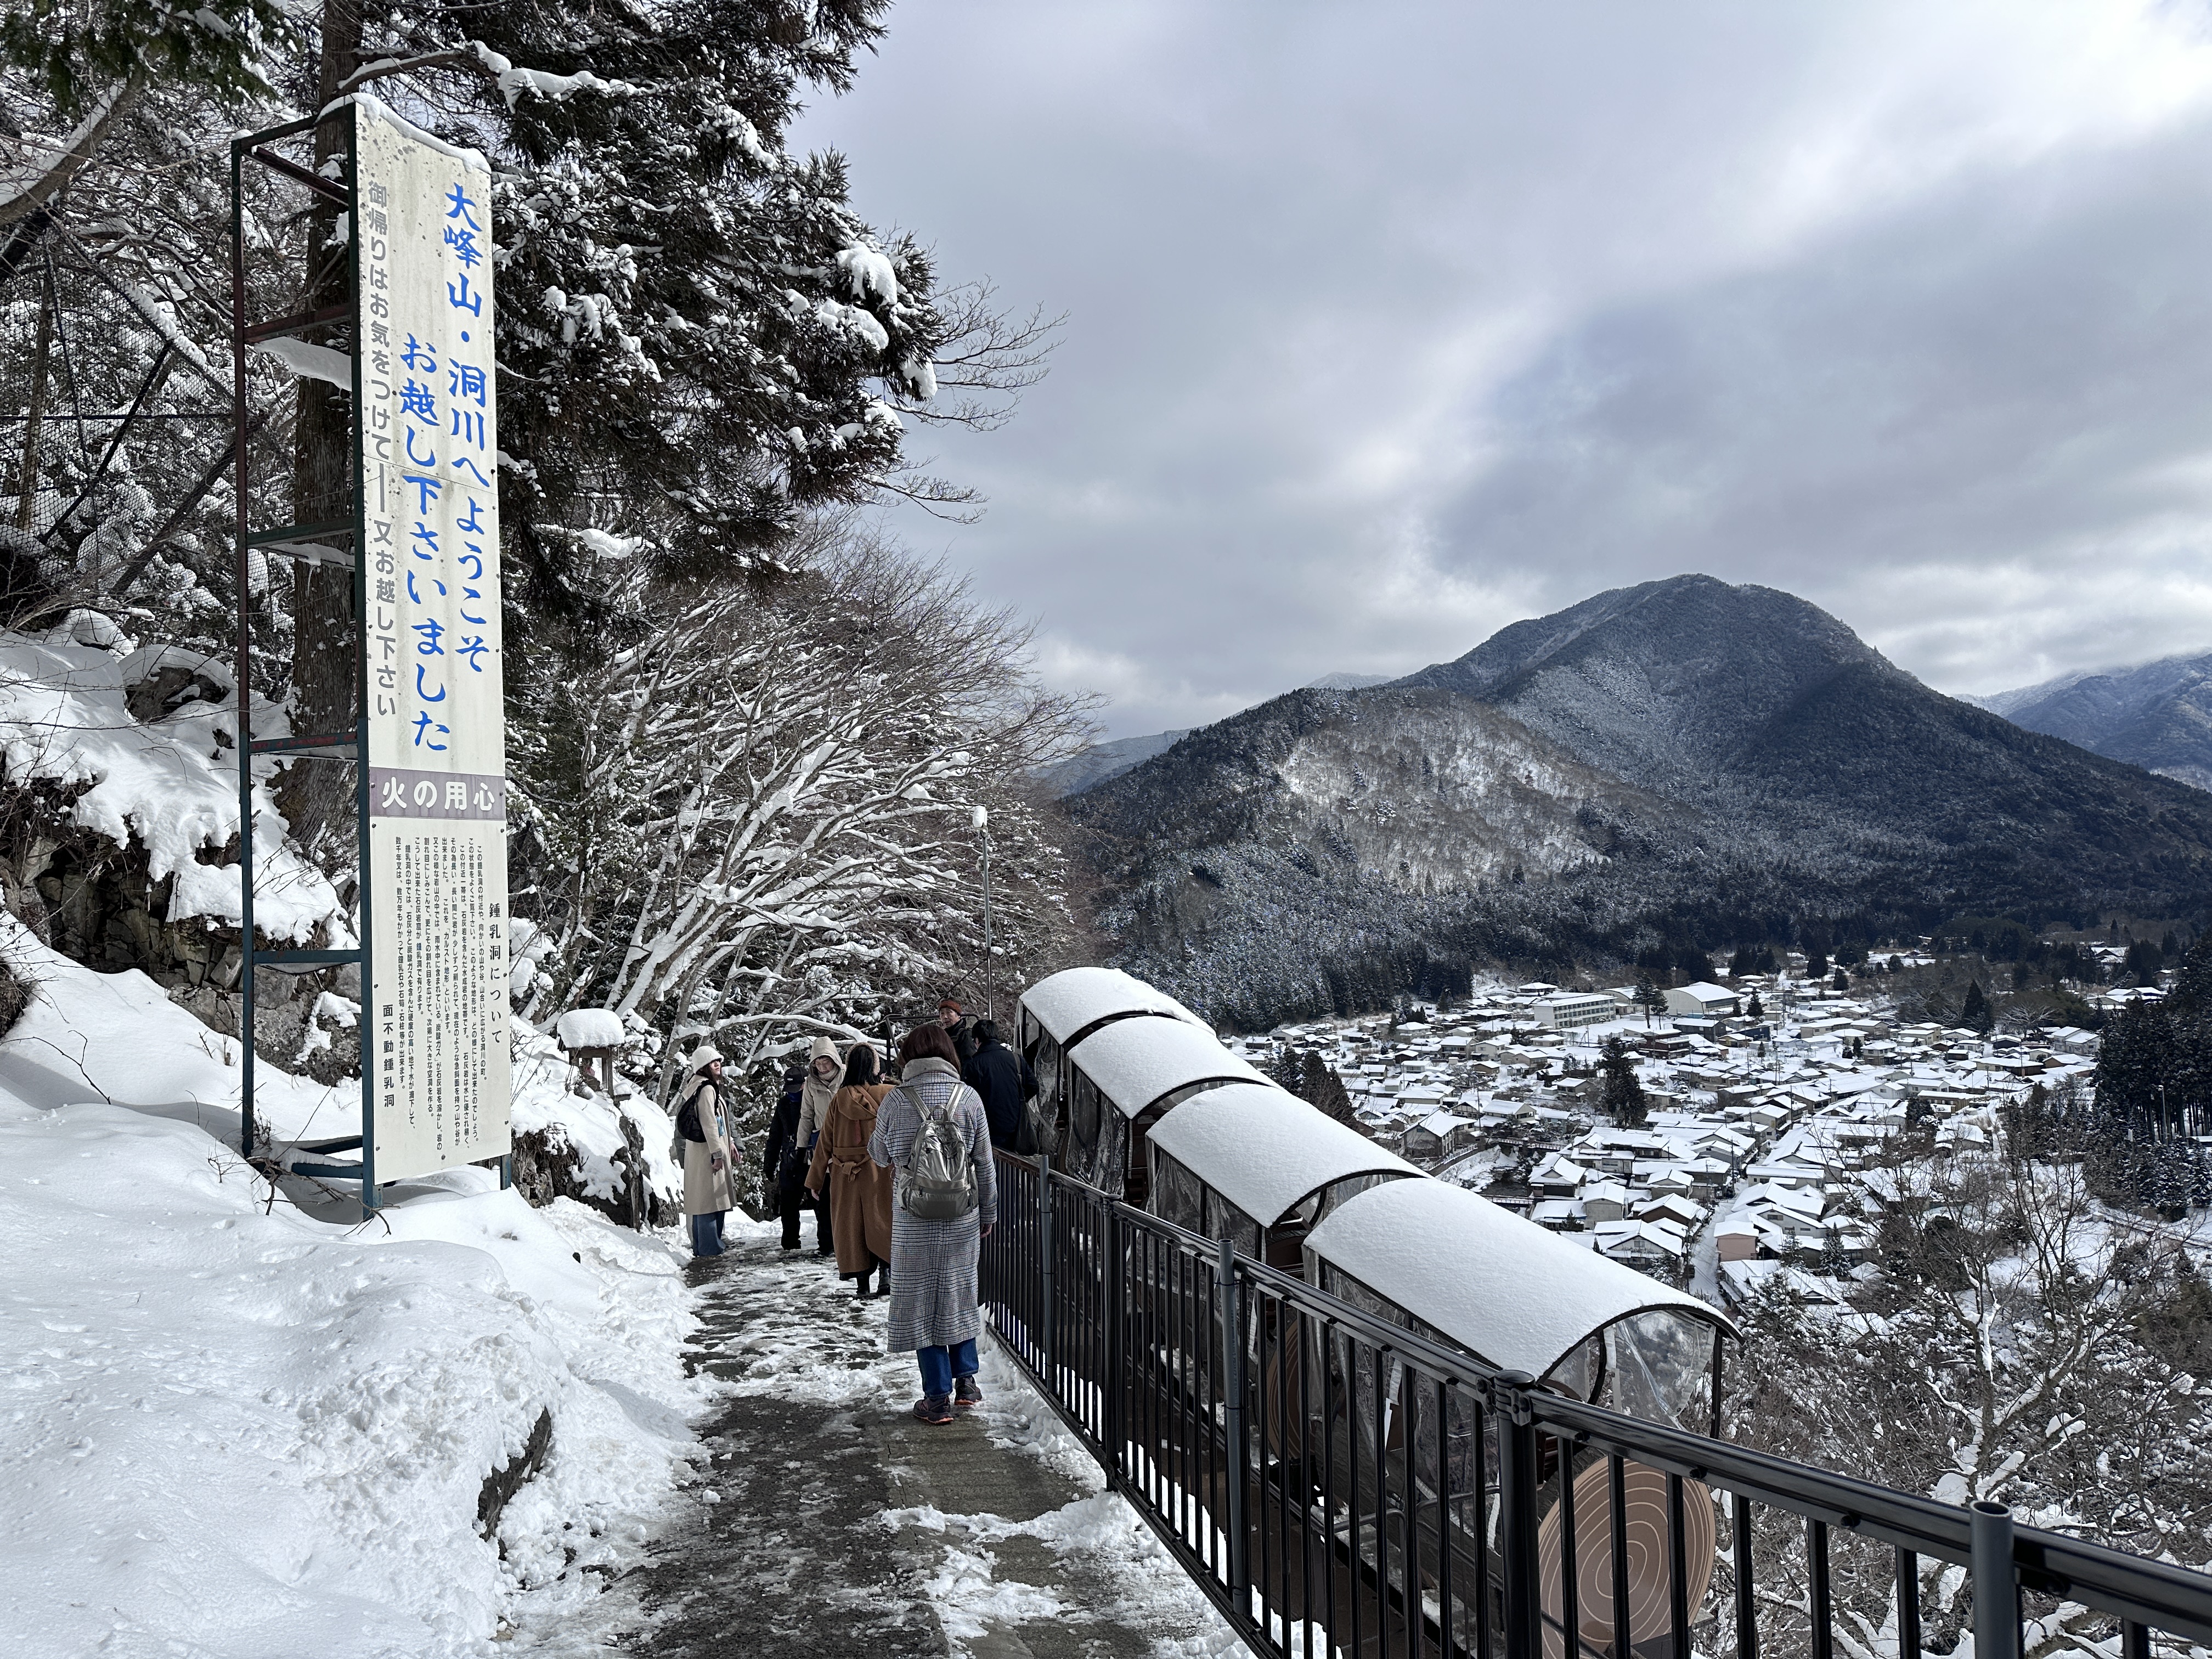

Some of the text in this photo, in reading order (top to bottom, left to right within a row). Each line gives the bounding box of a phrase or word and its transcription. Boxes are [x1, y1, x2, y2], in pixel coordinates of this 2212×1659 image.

[443, 182, 489, 673] 大峰山・洞川へようこそ
[399, 332, 450, 751] お越し下さいました
[381, 776, 495, 811] 火の用心
[489, 902, 502, 1043] 鍾乳洞について
[383, 1004, 394, 1108] 面不動鍾乳洞
